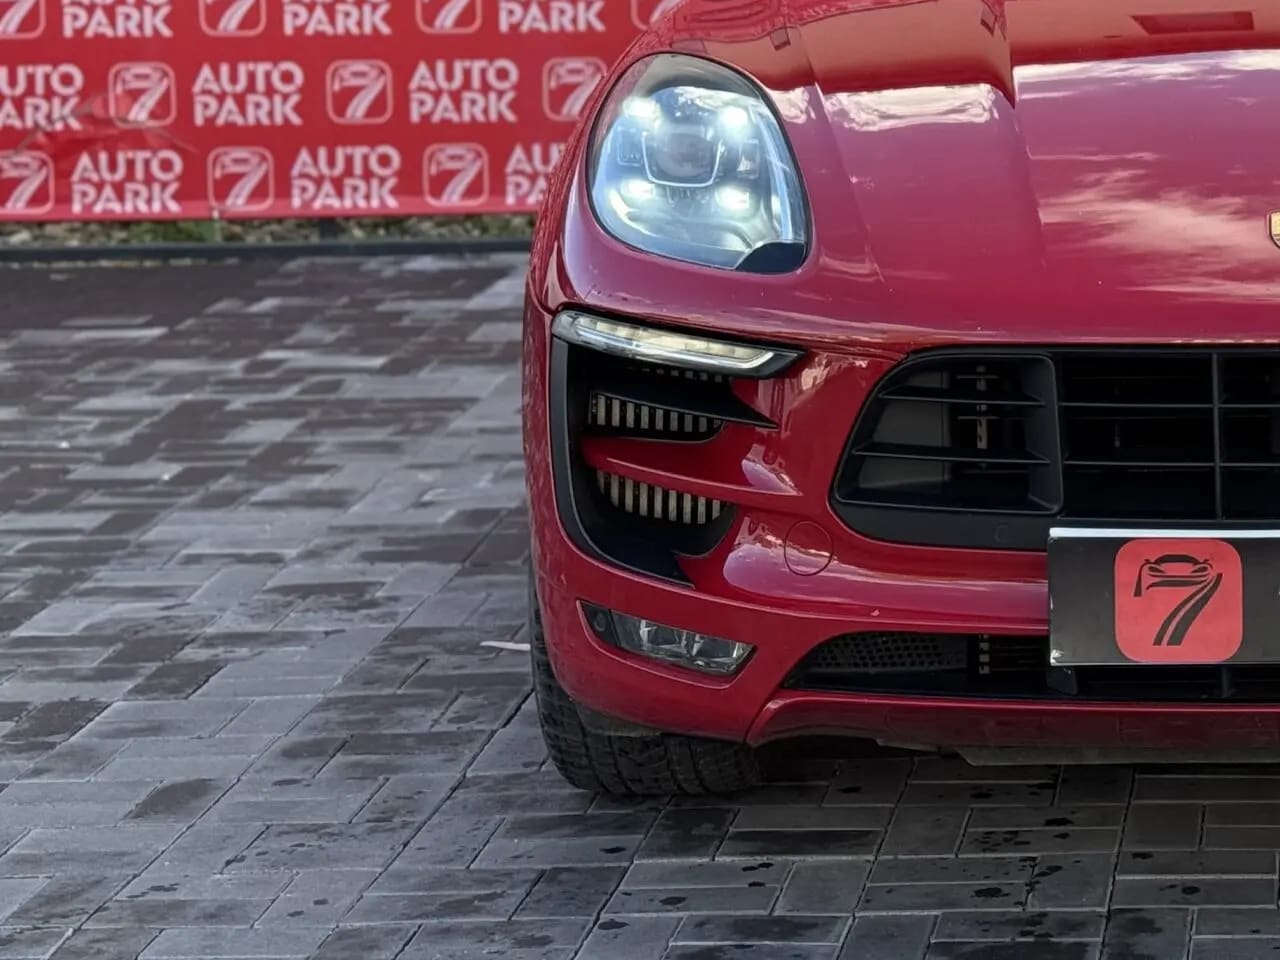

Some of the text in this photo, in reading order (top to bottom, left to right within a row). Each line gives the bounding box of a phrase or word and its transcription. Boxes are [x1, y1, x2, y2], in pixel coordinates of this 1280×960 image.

[63, 5, 172, 37] PARK
[284, 2, 390, 35] PARK
[499, 0, 605, 32] PARK
[192, 61, 304, 94] AUTO
[409, 59, 518, 91] AUTO
[194, 93, 301, 126] PARK
[410, 90, 516, 122] PARK
[71, 150, 183, 182] AUTO
[291, 145, 400, 177] AUTO
[71, 181, 179, 213] PARK
[291, 176, 397, 208] PARK
